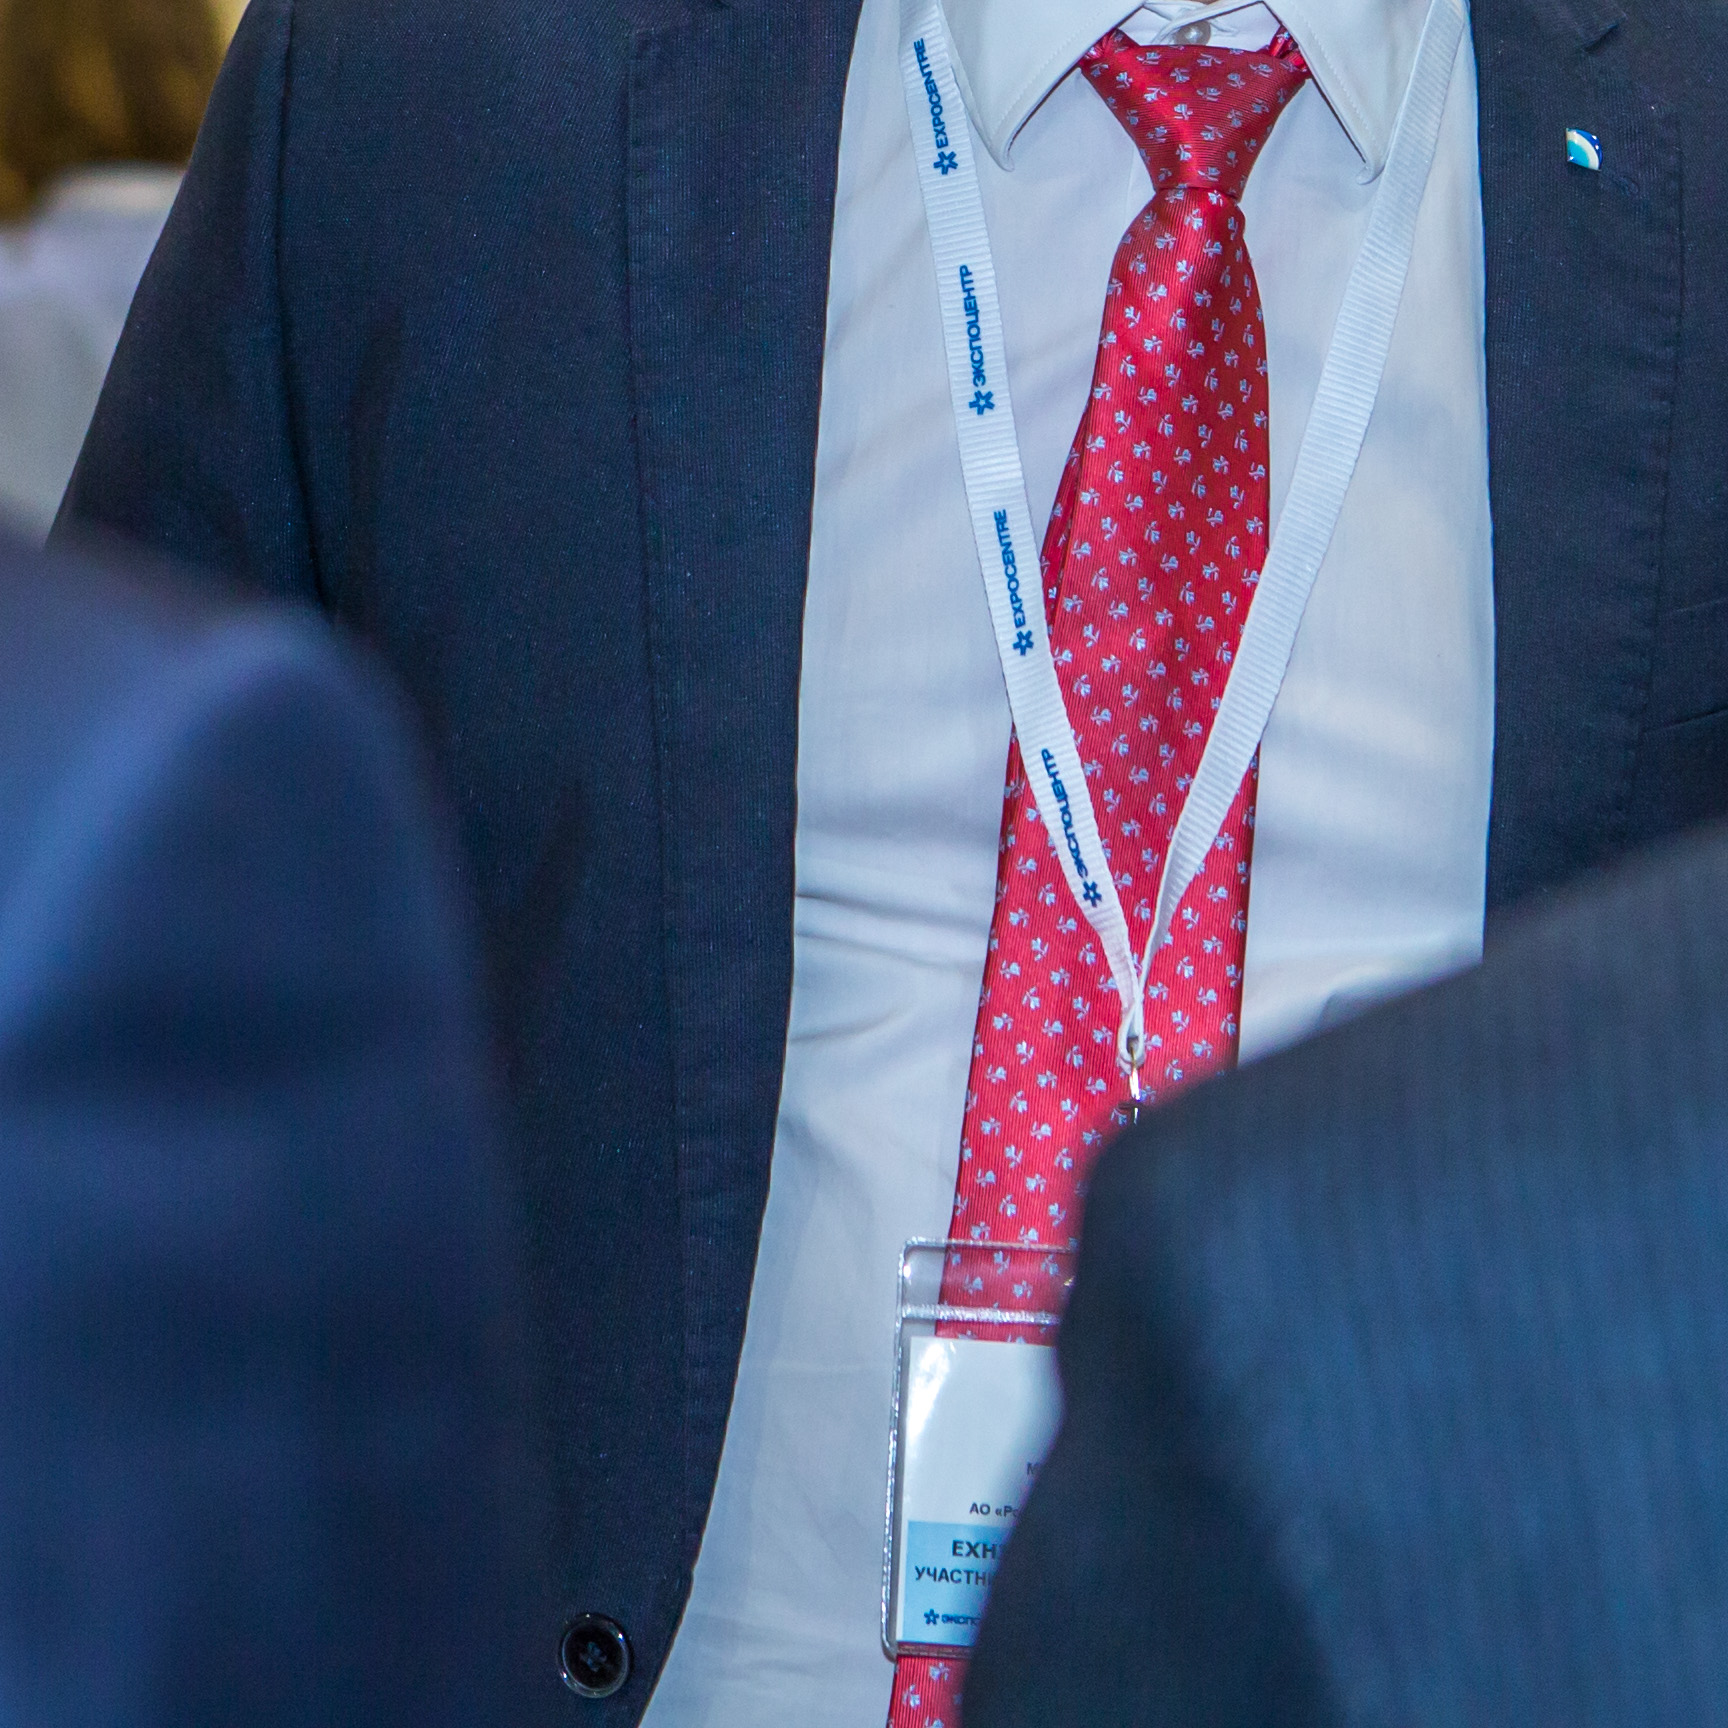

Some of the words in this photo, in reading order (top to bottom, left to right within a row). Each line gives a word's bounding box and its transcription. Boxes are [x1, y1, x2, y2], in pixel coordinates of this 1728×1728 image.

[913, 38, 948, 149] EXPOCENTRE
[959, 264, 987, 386] ЭКСПОЦЕНТР
[993, 509, 1026, 628] EXPOCENTRE
[1041, 748, 1088, 879] ЭКСПОЦЕНТР
[969, 1501, 991, 1516] АО
